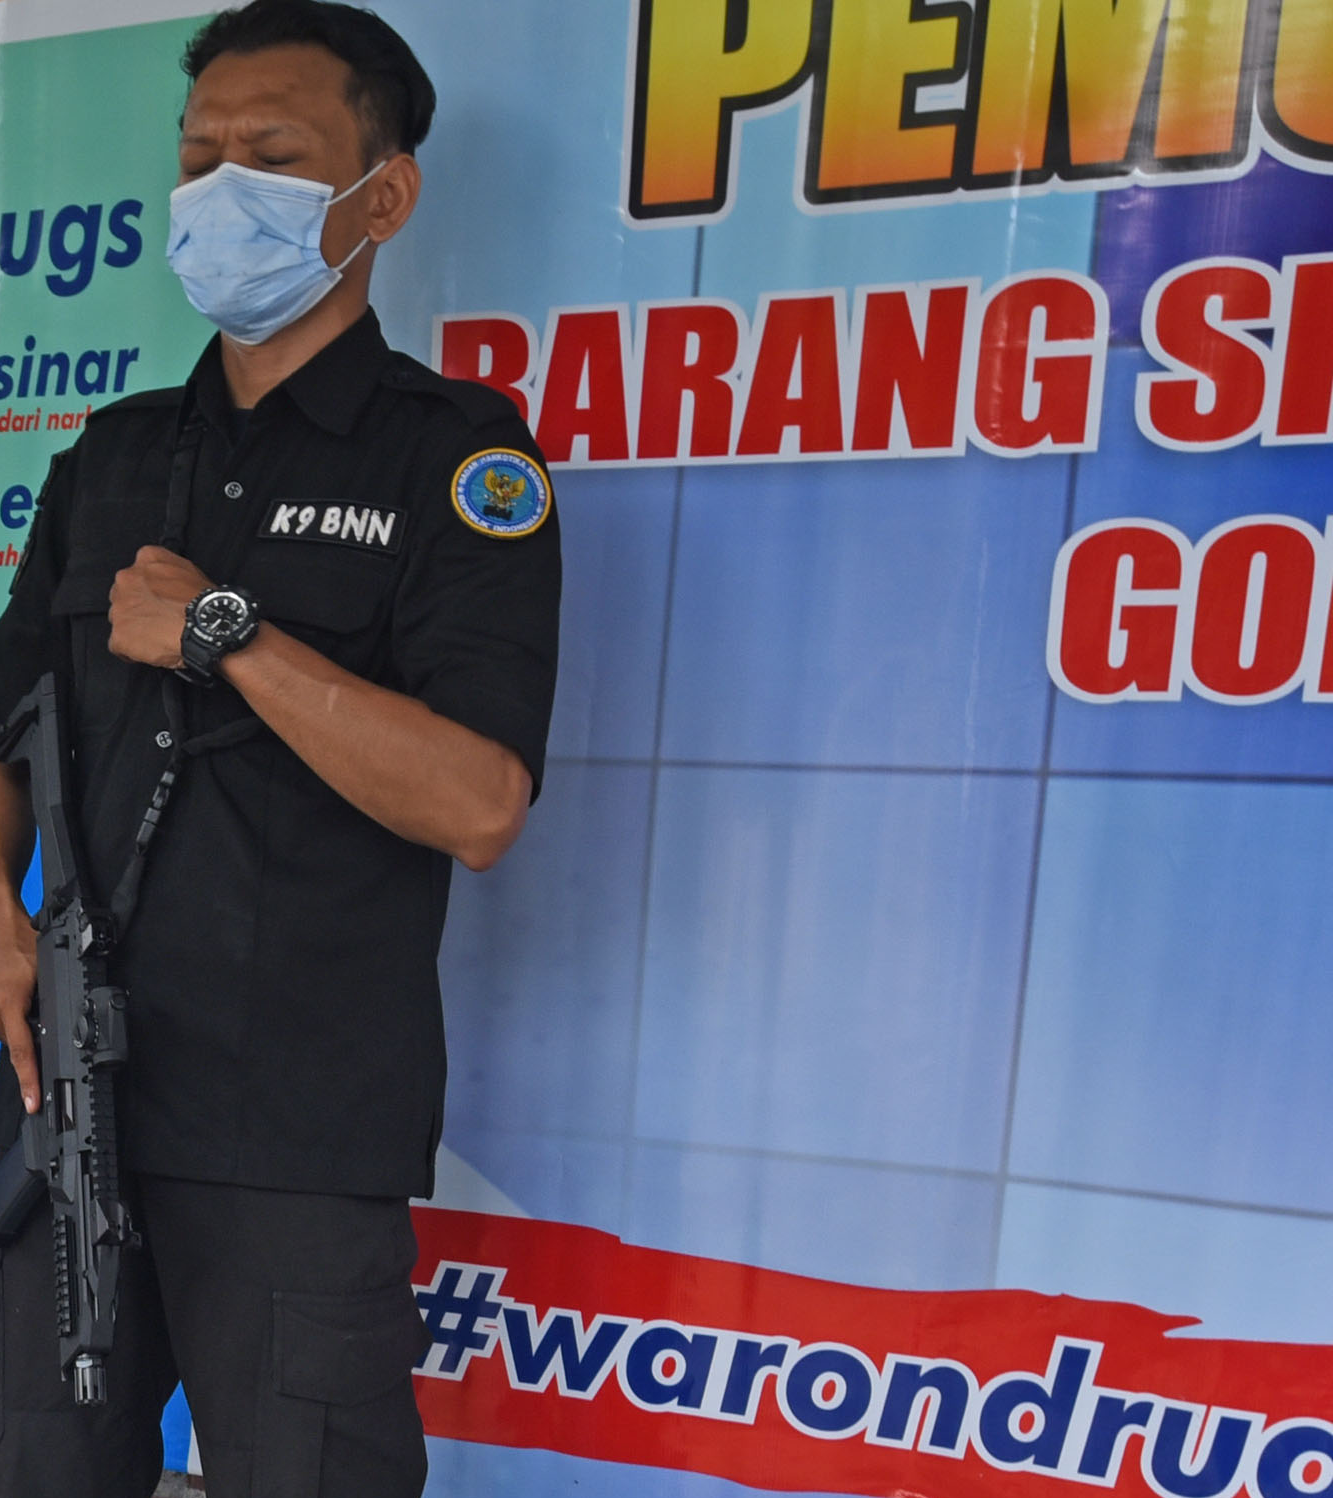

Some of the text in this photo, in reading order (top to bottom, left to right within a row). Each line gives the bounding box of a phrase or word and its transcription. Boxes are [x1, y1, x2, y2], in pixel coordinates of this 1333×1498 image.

[438, 274, 1100, 466] BARANG
[269, 504, 396, 546] K9 BNN
[1061, 523, 1333, 698] GO
